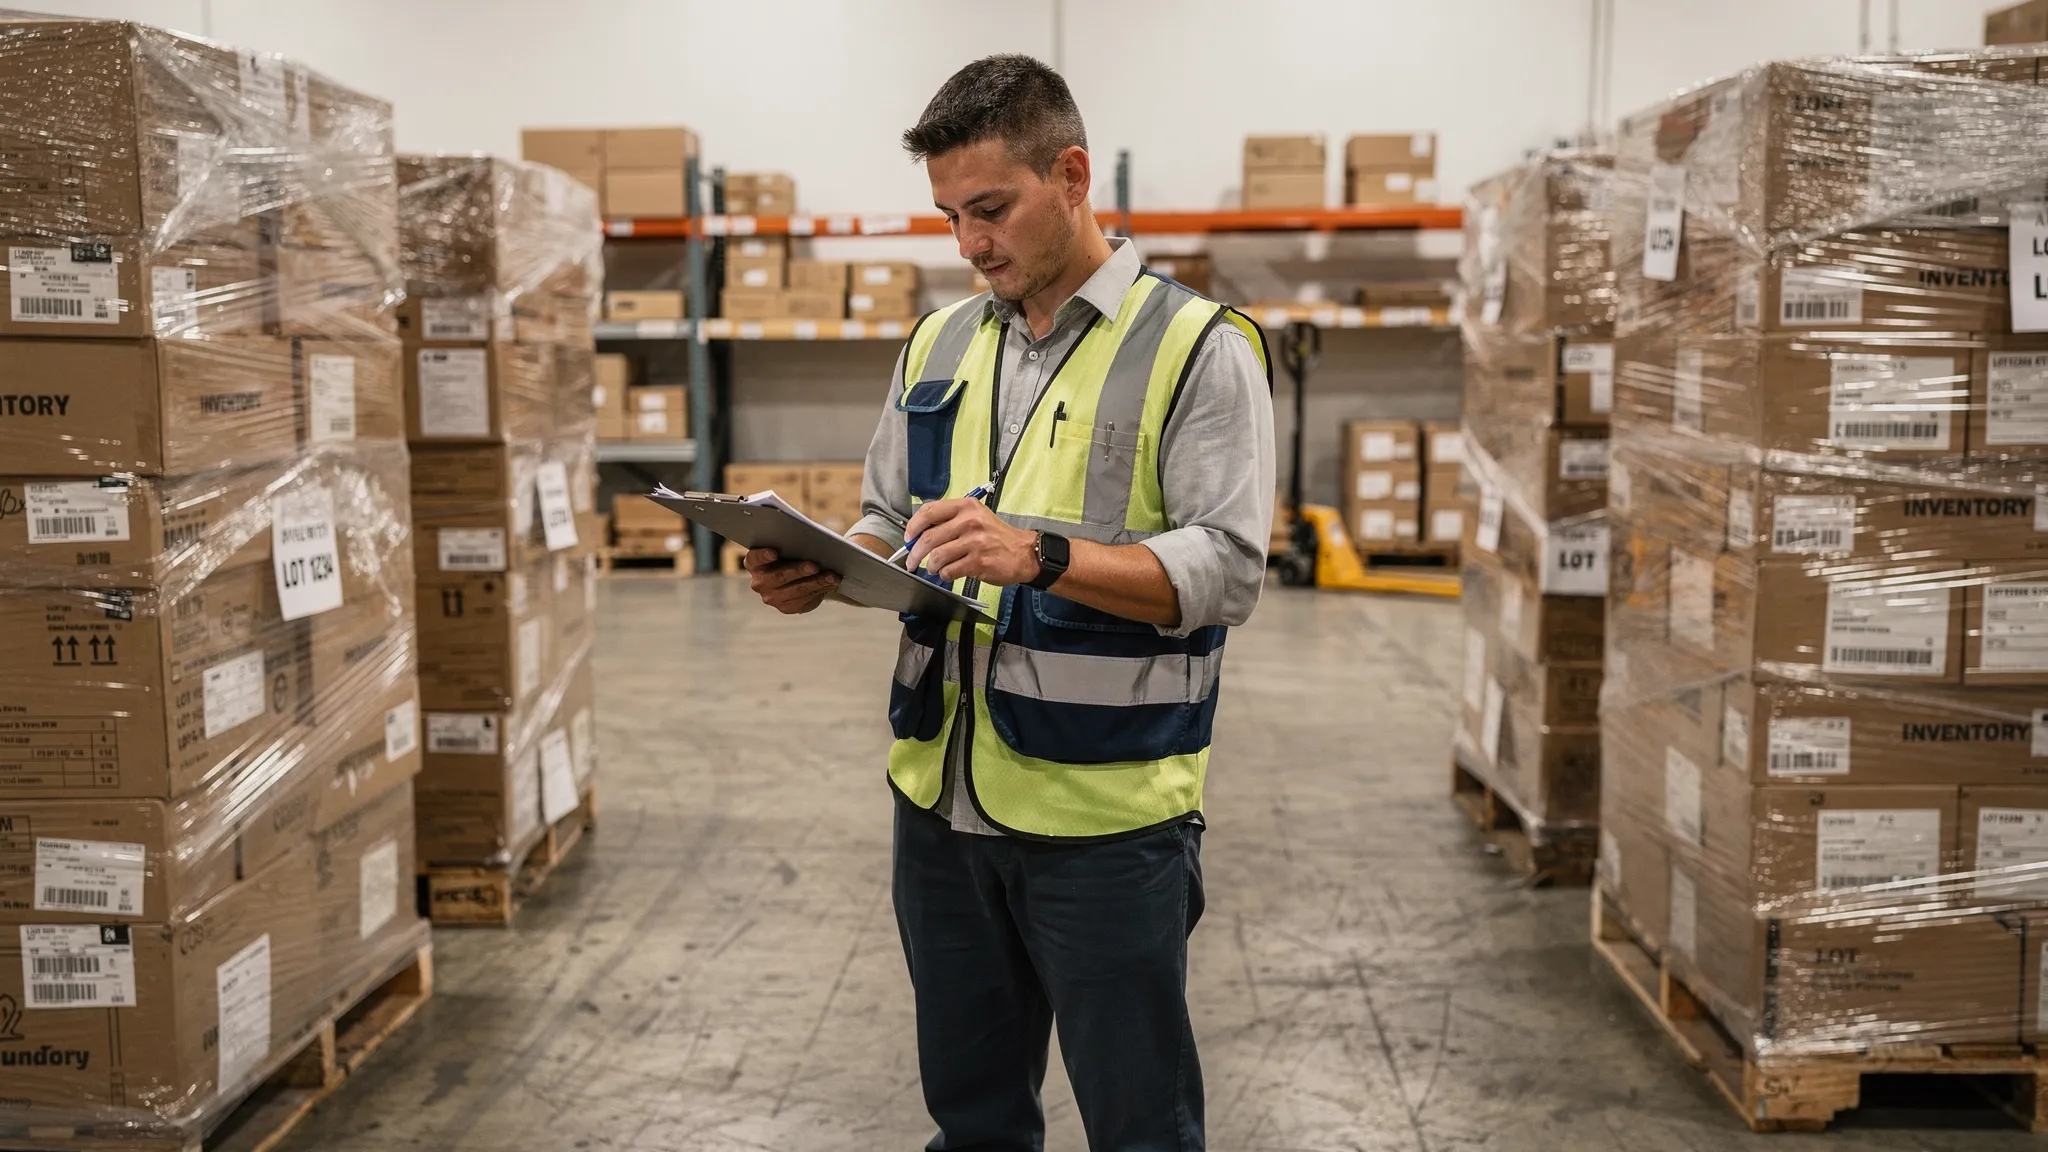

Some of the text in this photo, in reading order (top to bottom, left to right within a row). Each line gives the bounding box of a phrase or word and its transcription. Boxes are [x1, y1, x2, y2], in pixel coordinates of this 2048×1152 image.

[0, 394, 70, 416] TORY
[1904, 497, 2030, 517] INVENTORY
[1559, 551, 1596, 570] LOT
[283, 558, 305, 588] LOT
[1902, 723, 2030, 742] INVENTORY
